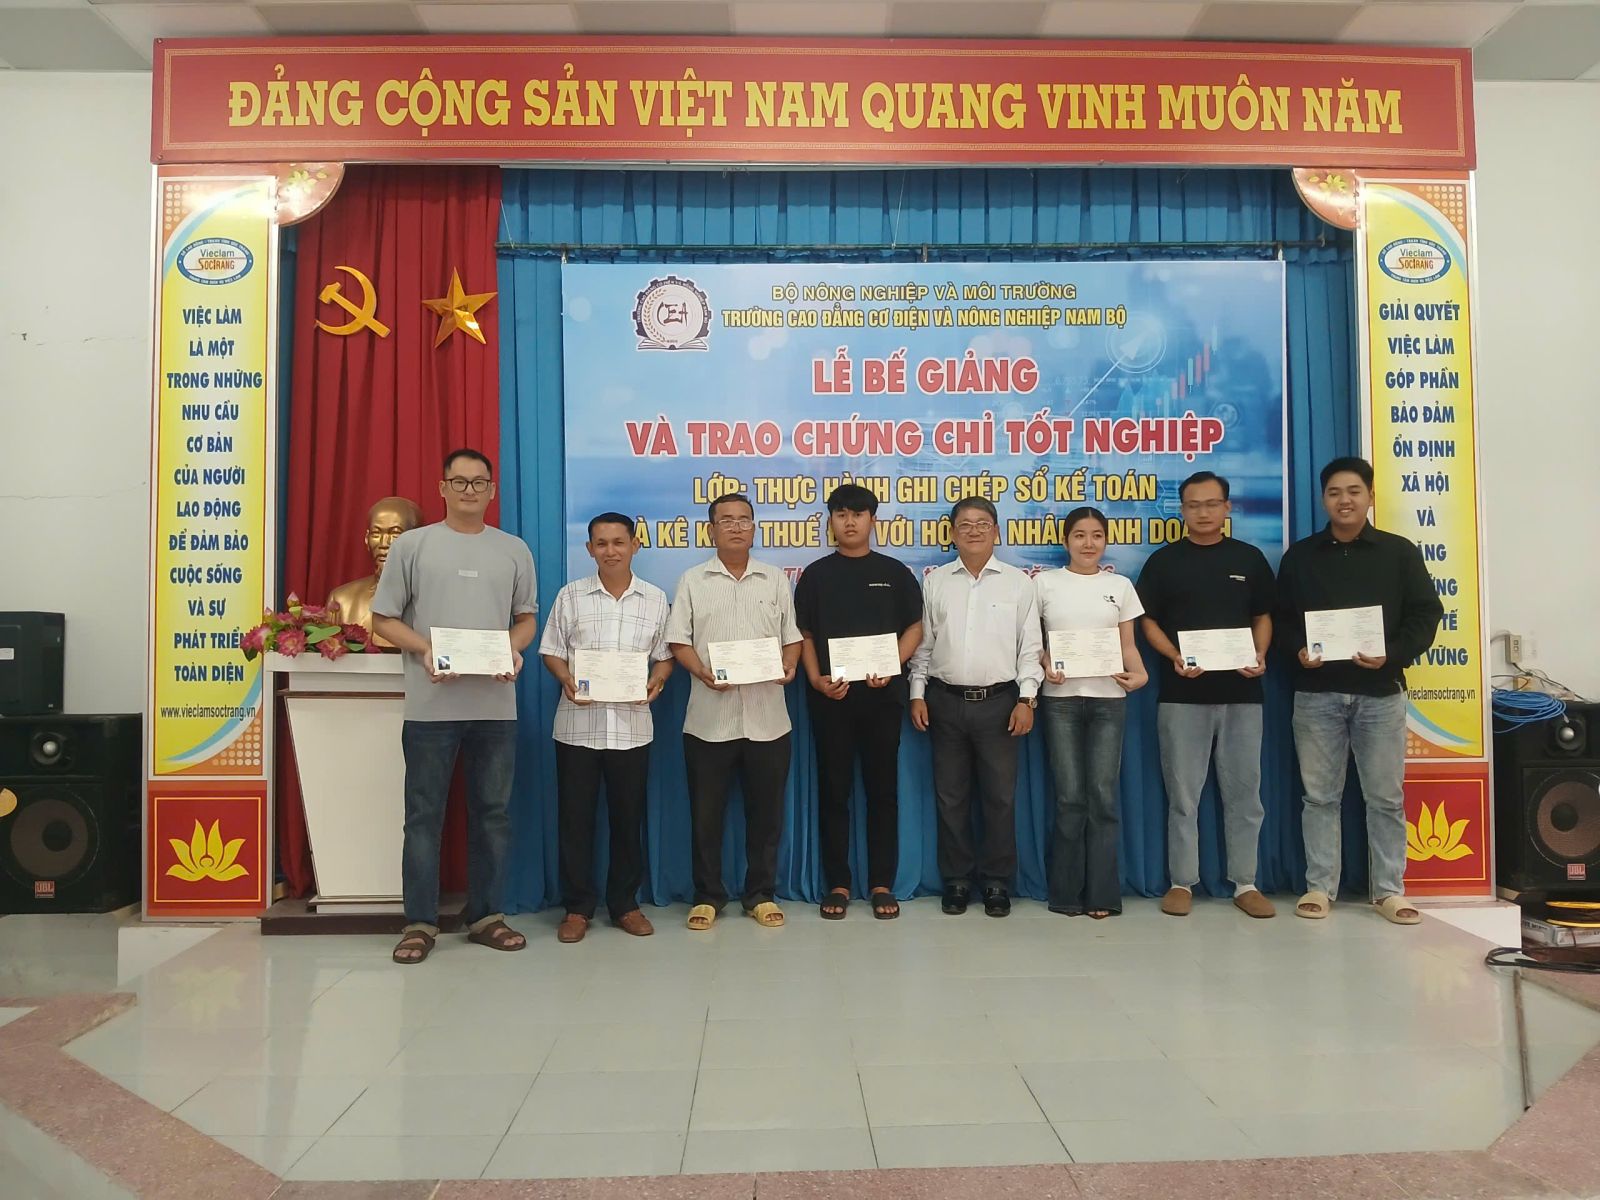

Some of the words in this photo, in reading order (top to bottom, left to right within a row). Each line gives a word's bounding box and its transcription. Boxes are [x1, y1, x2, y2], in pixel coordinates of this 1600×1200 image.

[228, 64, 364, 126] ĐẢNG
[376, 68, 510, 137] CỘNG
[523, 62, 618, 127] SẢN
[630, 68, 733, 138] VIỆT
[745, 81, 849, 127] NAM
[862, 82, 1027, 132] QUANG
[1038, 84, 1147, 130] VINH
[1158, 73, 1291, 131] MUÔN
[1302, 77, 1403, 134] NĂM
[200, 249, 235, 257] Vieclam
[1400, 249, 1433, 257] Vieclam
[771, 282, 796, 304] BỘ
[803, 282, 855, 301] NÔNG
[860, 282, 929, 304] NGHIỆP
[933, 281, 958, 301] VÀ
[963, 281, 996, 300] MÔI
[1000, 282, 1076, 300] TRƯỜNG
[183, 306, 211, 327] VIỆC
[216, 305, 242, 324] LÀM
[722, 306, 783, 328] TRƯỜNG
[787, 309, 818, 328] CAO
[821, 302, 864, 328] ĐẲNG
[868, 307, 891, 328] CƠ
[893, 305, 930, 331] ĐIỆN
[933, 306, 953, 327] VÀ
[957, 305, 1001, 327] NÔNG
[1004, 305, 1061, 330] NGHIỆP
[1065, 308, 1101, 326] NAM
[1106, 304, 1128, 329] BỘ
[1379, 298, 1409, 321] GIẢI
[1414, 299, 1460, 321] QUYẾT
[190, 338, 203, 356] LÀ
[208, 337, 234, 359] MỘT
[1388, 334, 1420, 358] VIỆC
[1426, 334, 1454, 355] LÀM
[167, 372, 209, 388] TRONG
[214, 369, 262, 388] NHỮNG
[813, 347, 852, 394] LỄ
[863, 347, 906, 394] BẾ
[917, 350, 1039, 394] GIẢNG
[1385, 369, 1414, 389] GÓP
[1420, 367, 1459, 389] PHẦN
[182, 404, 210, 420] NHU
[215, 400, 238, 420] CẦU
[1391, 401, 1418, 423] BẢO
[1423, 401, 1455, 423] ĐẢM
[187, 434, 204, 452] CƠ
[207, 432, 232, 452] BẢN
[625, 415, 678, 456] VÀ
[686, 420, 782, 456] TRAO
[793, 412, 924, 456] CHỨNG
[933, 411, 996, 455] CHỈ
[1005, 407, 1074, 455] TỐT
[1084, 410, 1224, 462] NGHIỆP
[1393, 434, 1413, 458] ỔN
[1418, 440, 1455, 462] ĐỊNH
[174, 464, 198, 485] CỦA
[203, 466, 245, 485] NGƯỜI
[1401, 472, 1420, 492] XÃ
[1425, 471, 1449, 495] HỘI
[753, 474, 816, 509] THỰC
[897, 475, 937, 504] GHI
[944, 470, 1007, 501] CHÉP
[1014, 466, 1049, 502] SỔ
[1055, 467, 1089, 502] KẾ
[1092, 469, 1157, 501] TOÁN
[177, 501, 199, 517] LAO
[204, 498, 241, 520] ĐỘNG
[1416, 505, 1436, 527] VÀ
[169, 528, 187, 551] ĐỂ
[190, 529, 219, 550] ĐẢM
[224, 529, 248, 550] BẢO
[634, 516, 652, 548] À
[657, 516, 688, 548] KÊ
[759, 512, 823, 547] THUẾ
[875, 514, 914, 546] VỚI
[1107, 517, 1142, 545] NH
[170, 564, 202, 587] CUỘC
[207, 562, 242, 584] SỐNG
[188, 597, 204, 616] VÀ
[209, 598, 226, 620] SỰ
[1441, 609, 1458, 630] TẾ
[174, 629, 206, 649] PHÁT
[1426, 645, 1468, 666] VỮNG
[174, 661, 207, 681] TOÀN
[212, 661, 244, 685] DIỆN
[160, 704, 256, 721] www.vieclamsoctrang.vn
